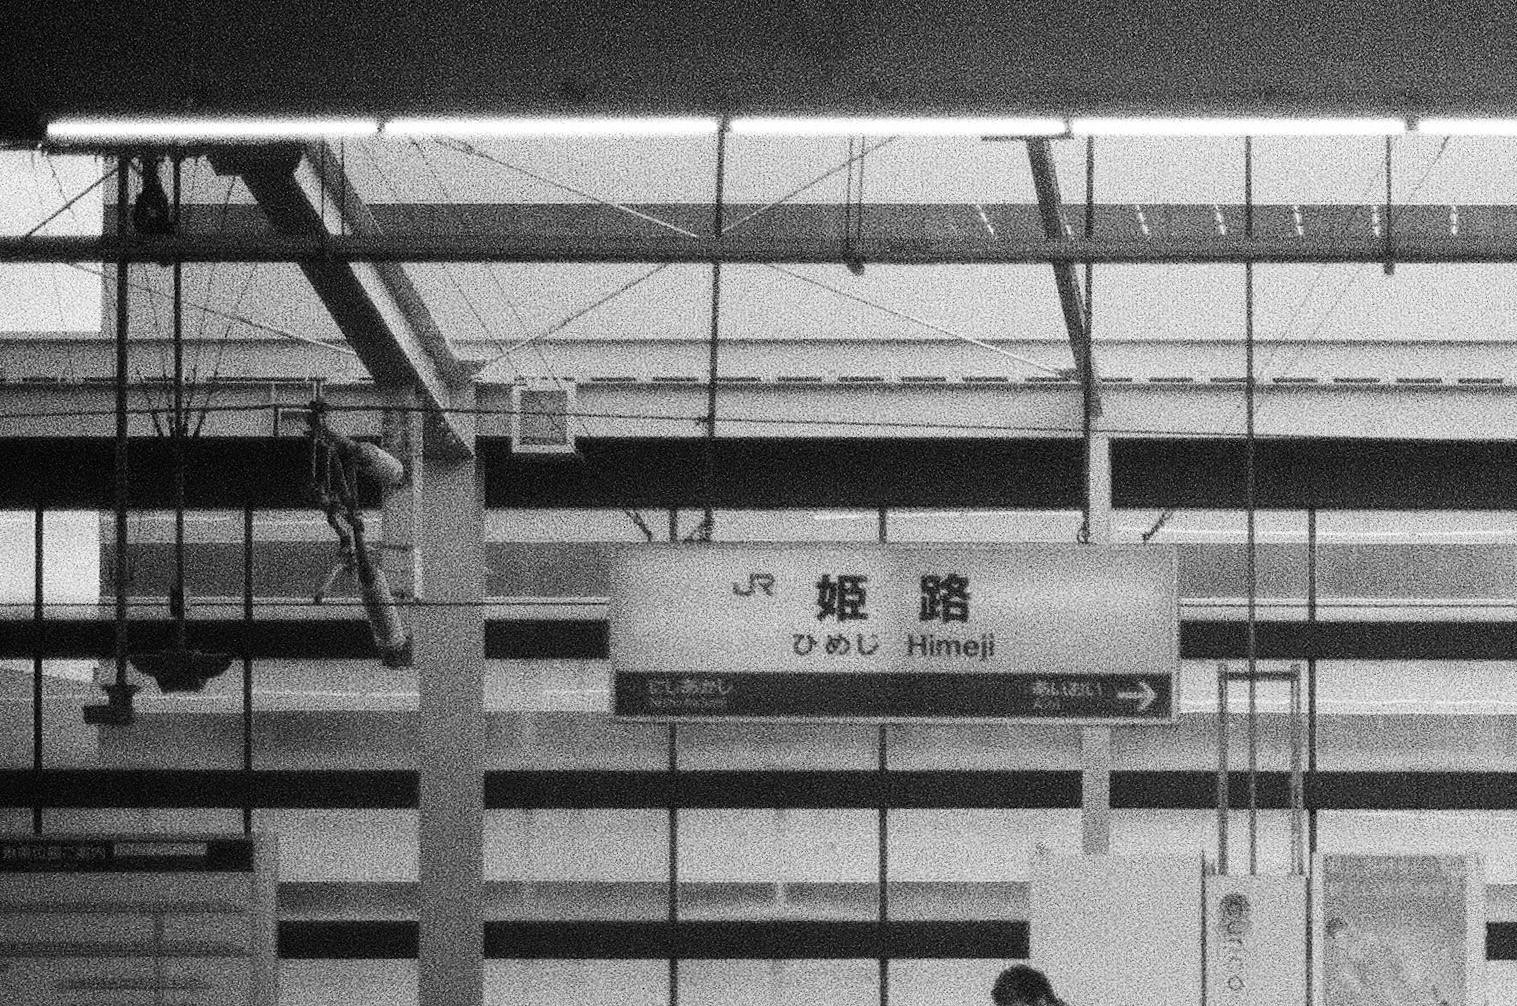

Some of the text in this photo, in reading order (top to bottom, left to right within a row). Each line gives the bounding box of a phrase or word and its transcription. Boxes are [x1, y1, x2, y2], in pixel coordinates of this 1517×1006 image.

[731, 572, 776, 597] JR
[815, 572, 971, 623] 姫路
[792, 632, 881, 657] ひめじ
[906, 632, 996, 661] Himeji
